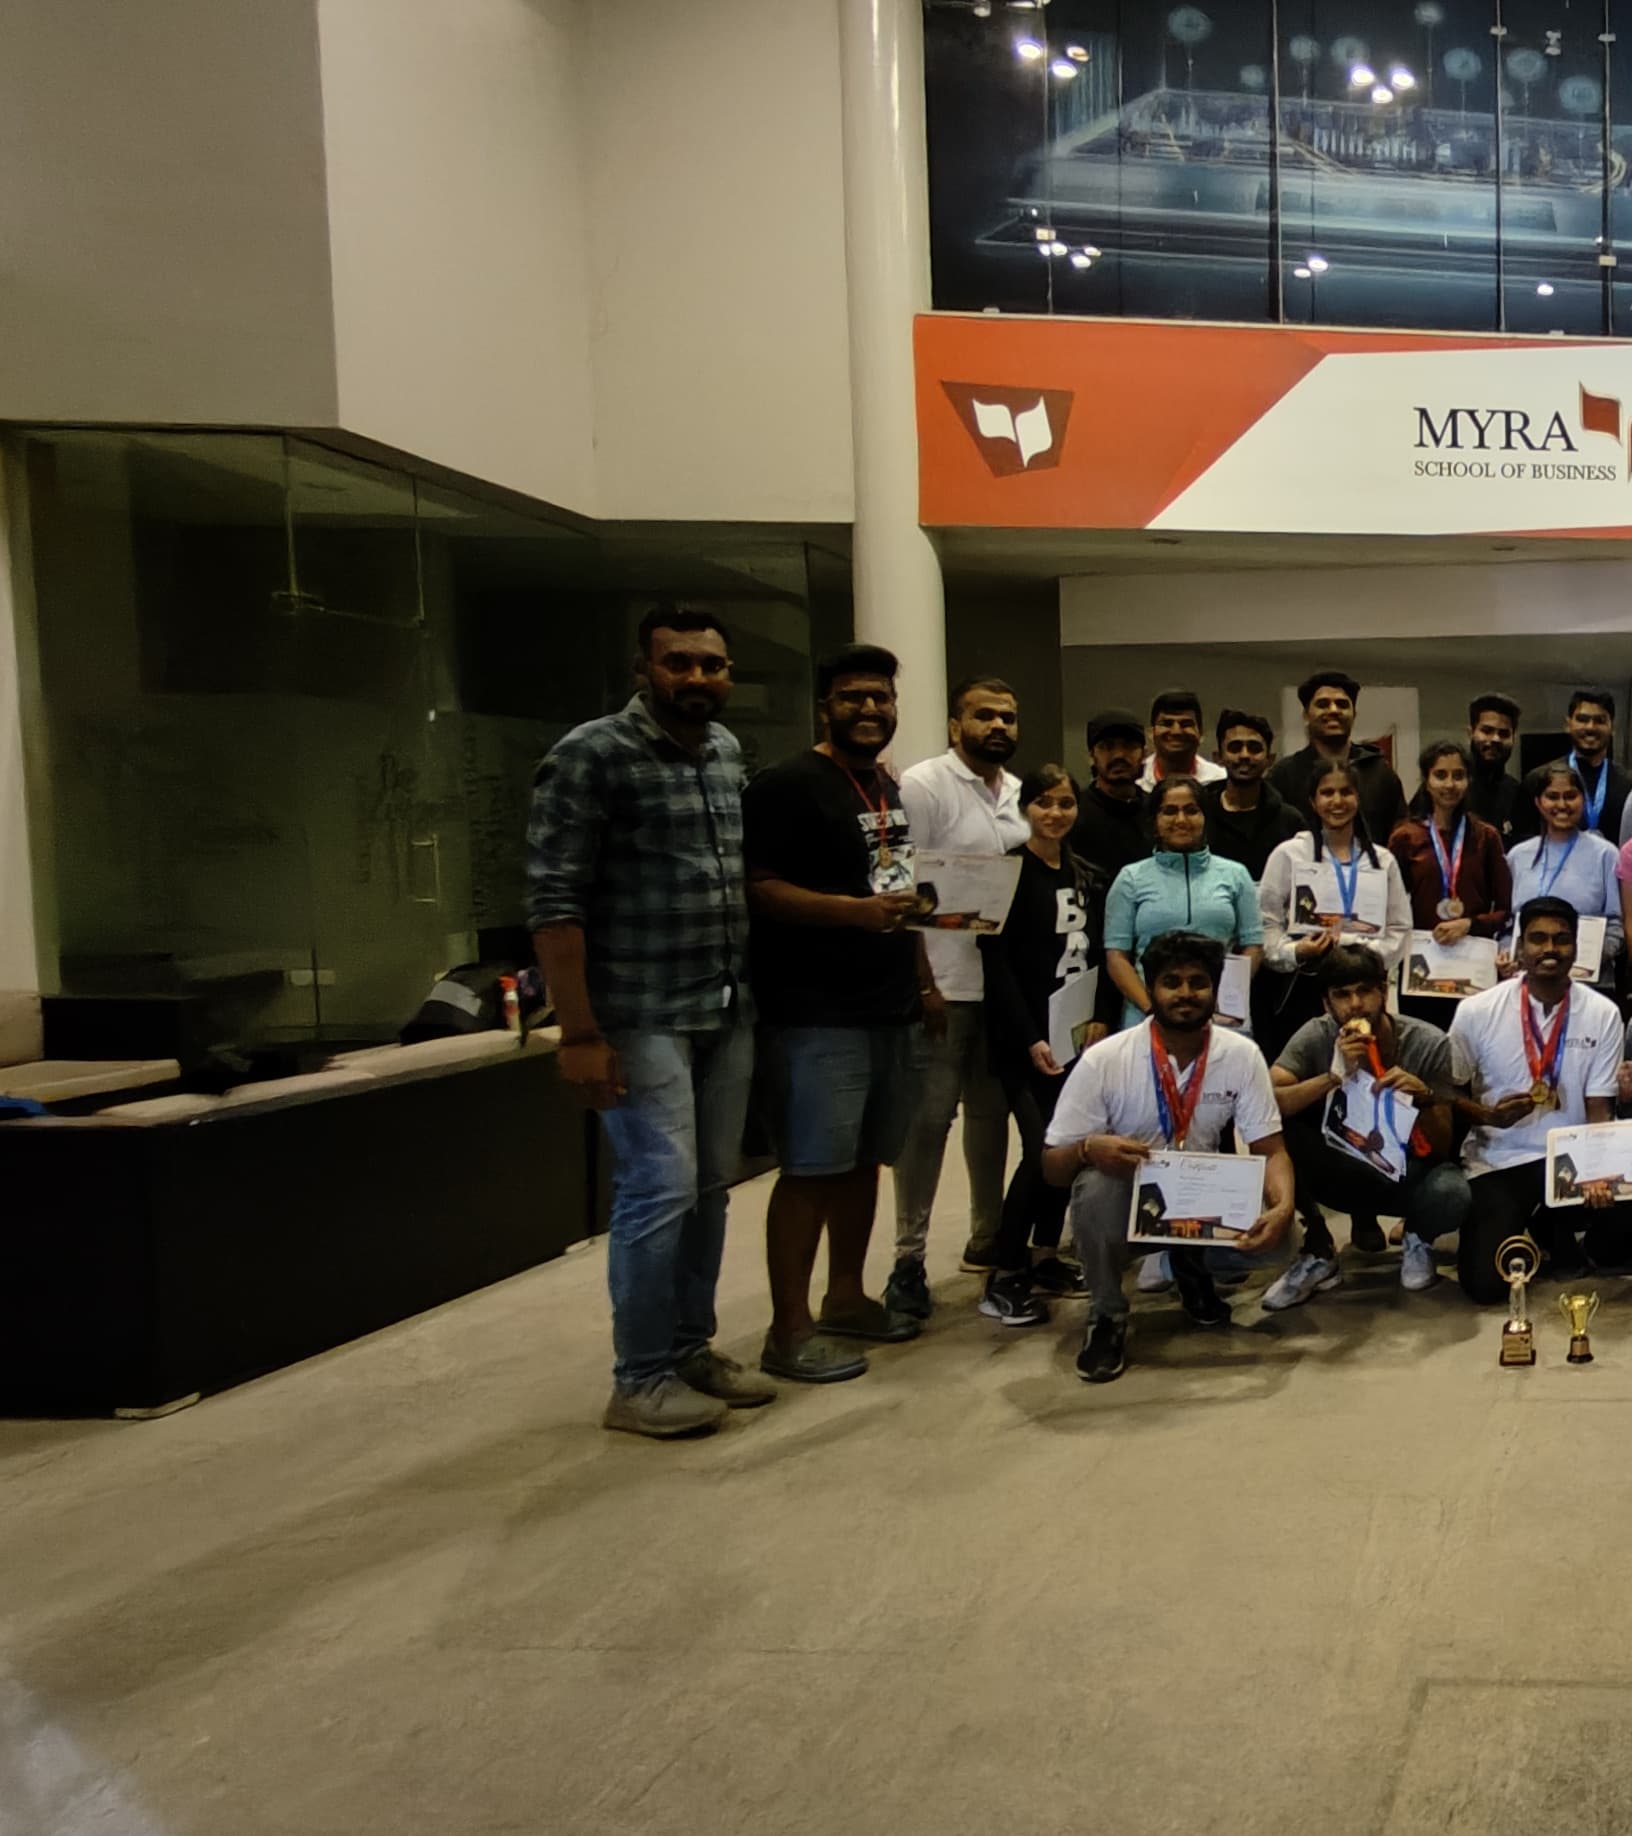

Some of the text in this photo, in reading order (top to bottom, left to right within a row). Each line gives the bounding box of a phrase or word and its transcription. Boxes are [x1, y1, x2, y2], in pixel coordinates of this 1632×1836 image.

[1413, 406, 1579, 452] MYRA
[1414, 460, 1617, 482] SCHOOL OF BUSINESS
